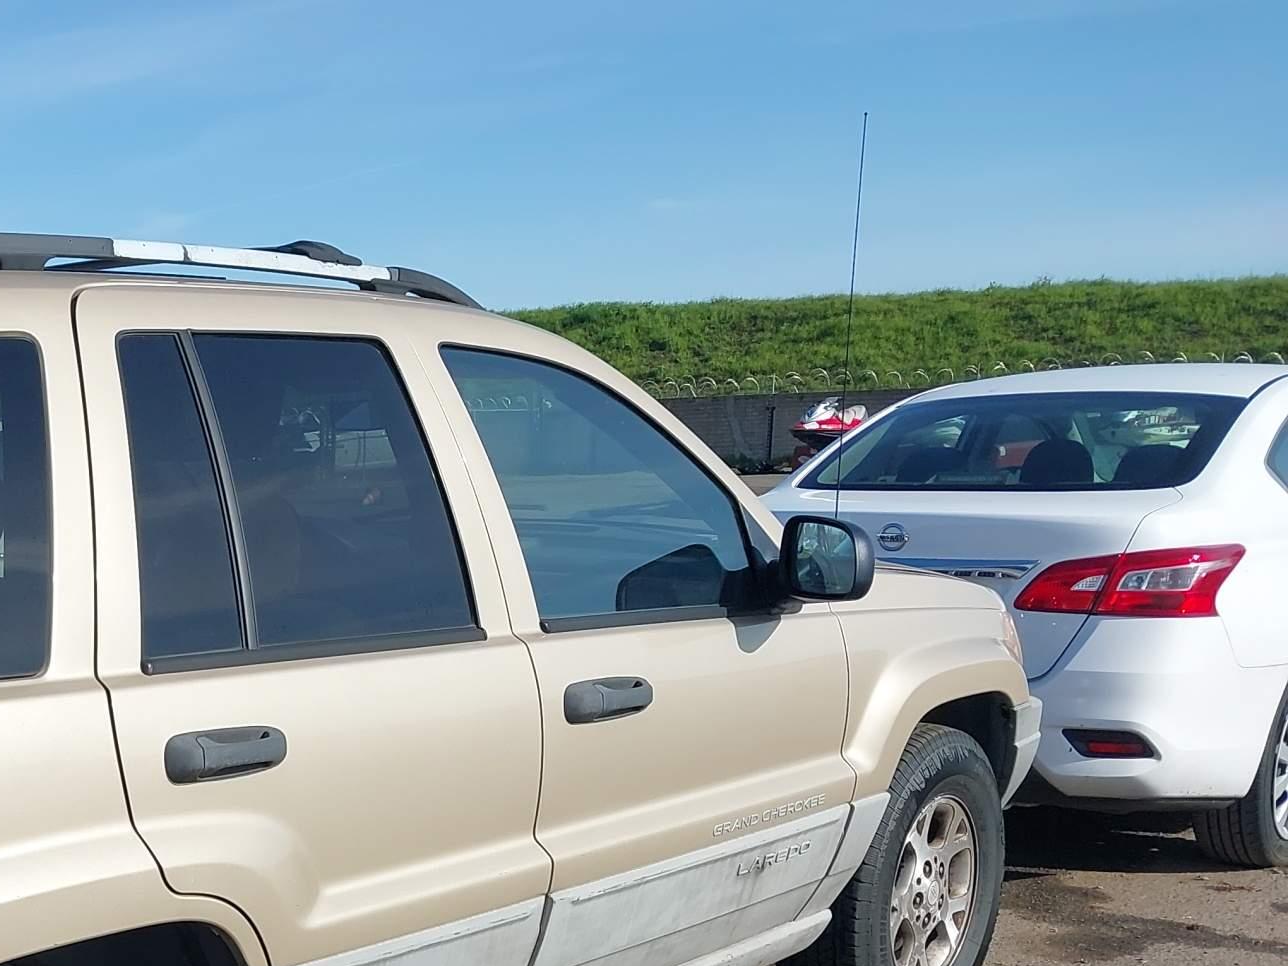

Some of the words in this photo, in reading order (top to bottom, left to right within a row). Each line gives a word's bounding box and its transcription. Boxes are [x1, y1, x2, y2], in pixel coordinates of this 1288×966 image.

[713, 813, 760, 837] GRAND
[762, 793, 826, 823] CHEROKEE
[736, 840, 812, 876] LAREDO
